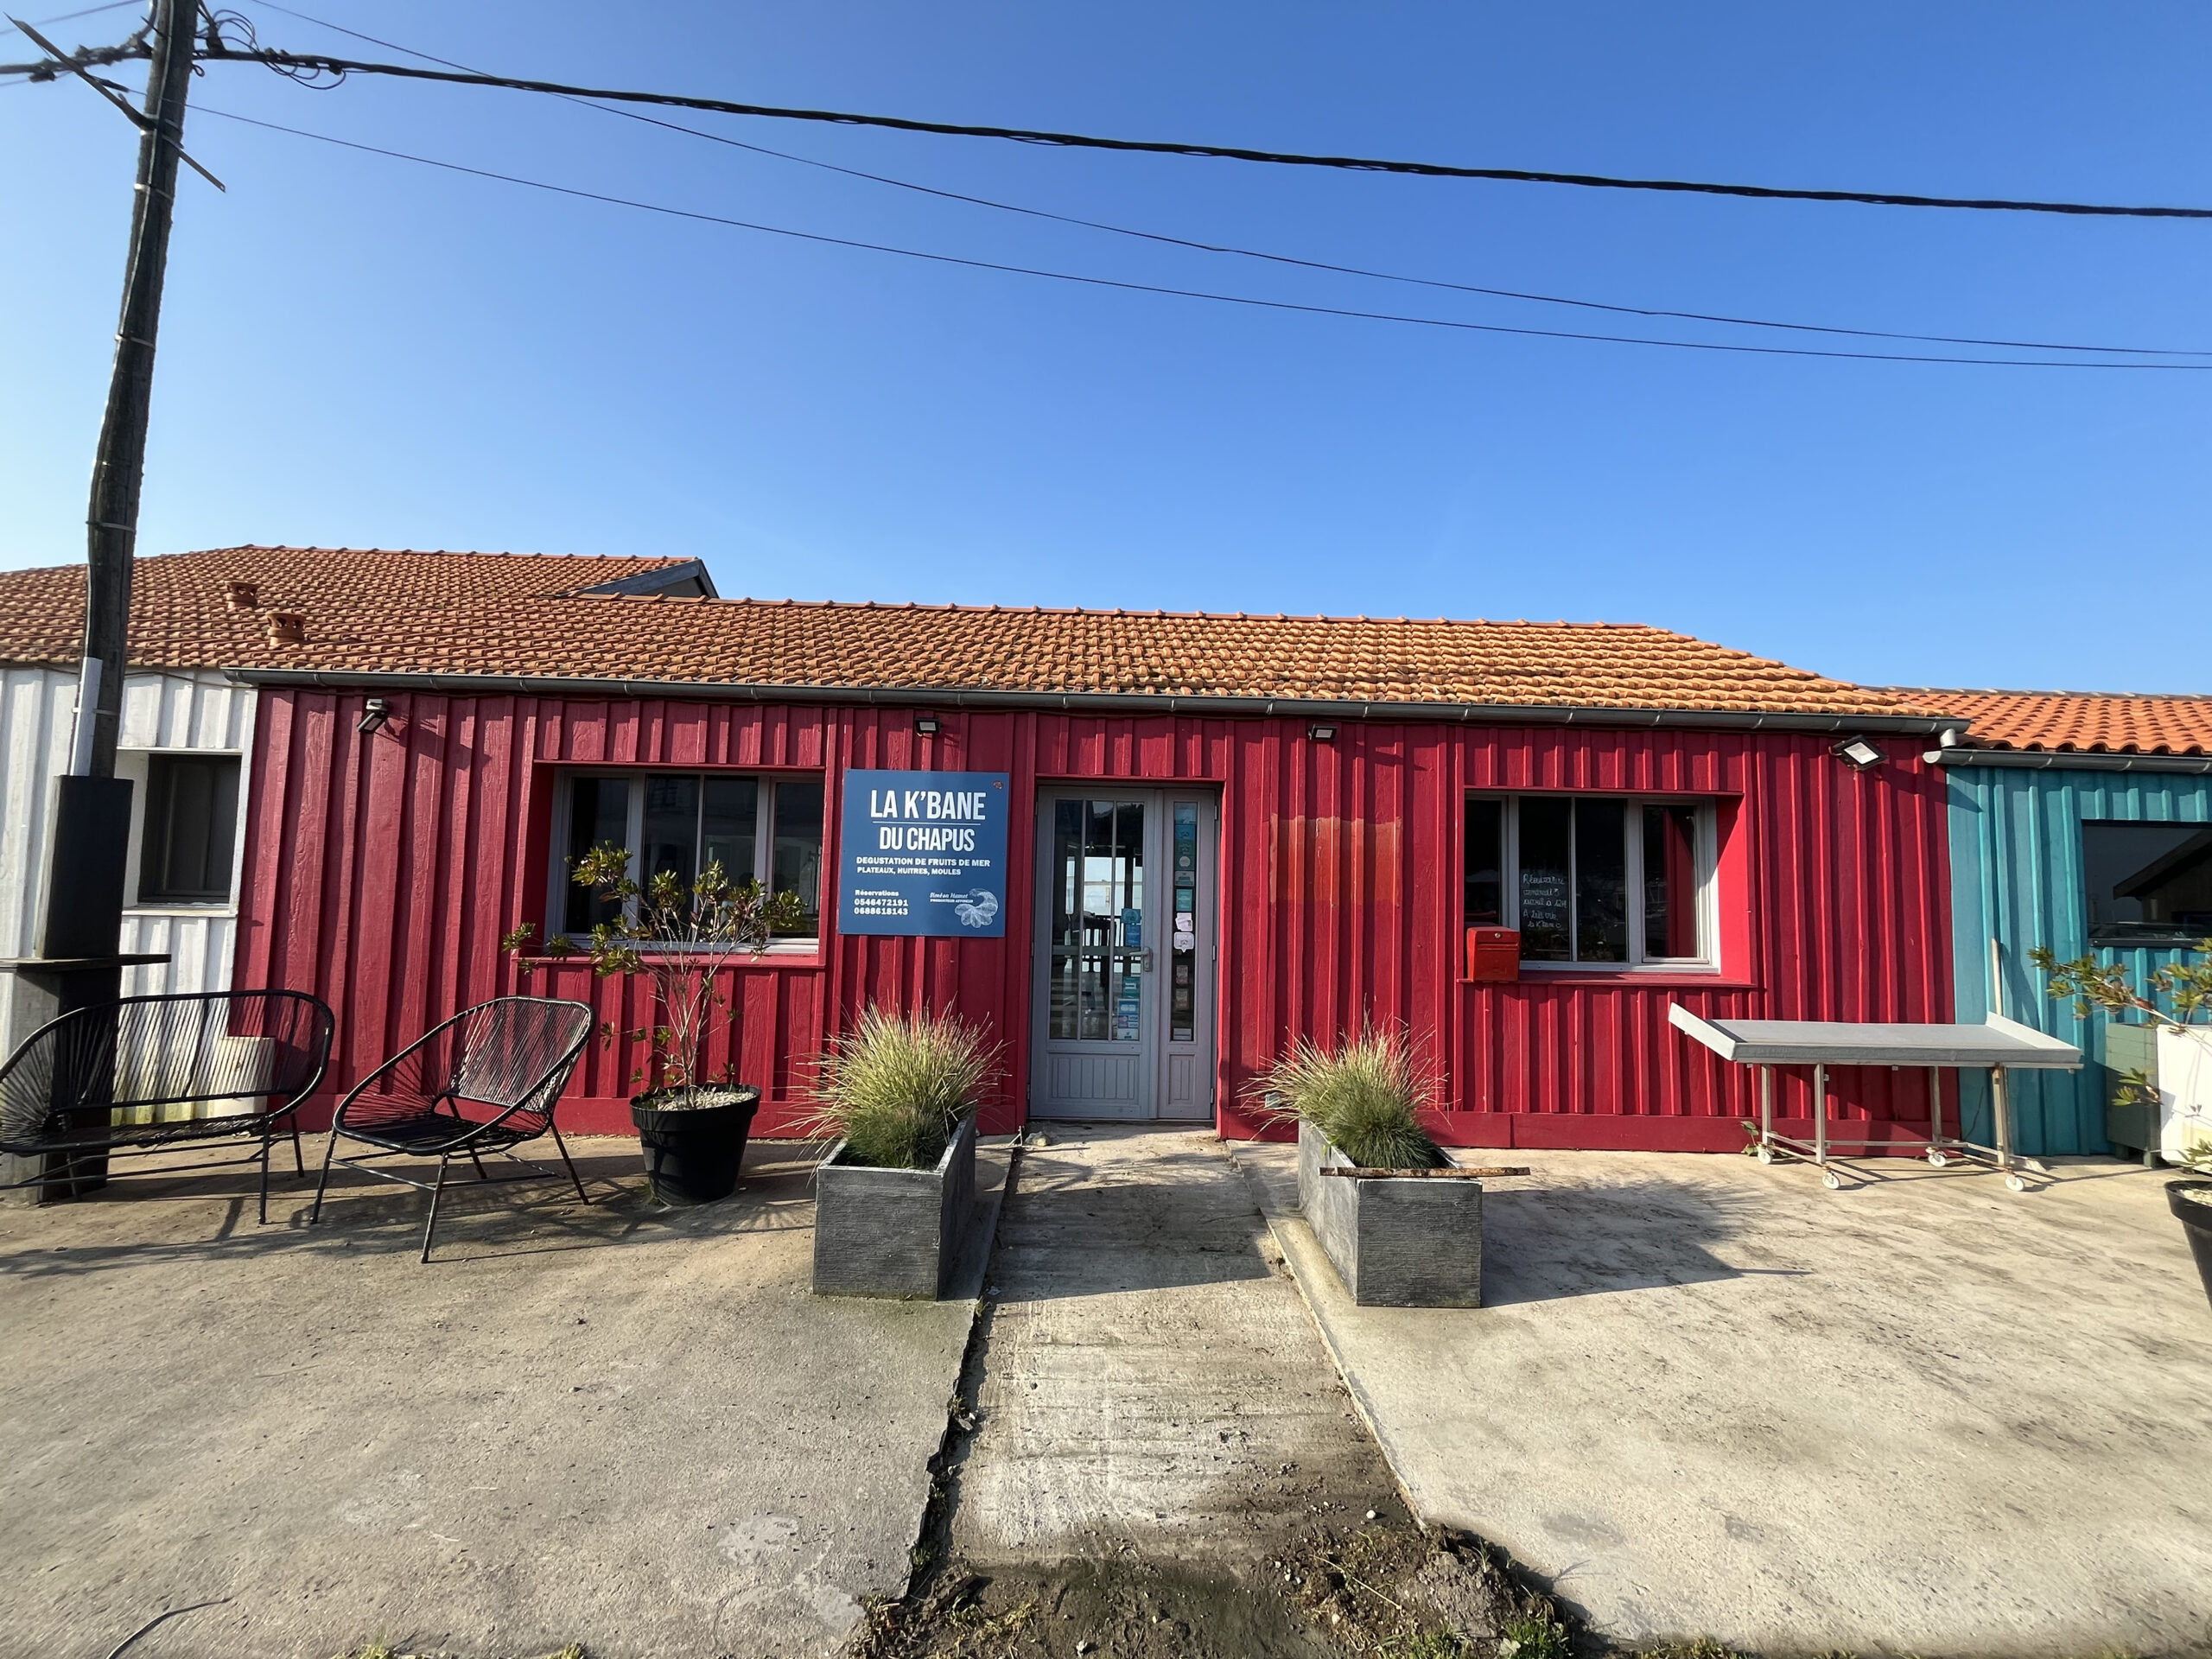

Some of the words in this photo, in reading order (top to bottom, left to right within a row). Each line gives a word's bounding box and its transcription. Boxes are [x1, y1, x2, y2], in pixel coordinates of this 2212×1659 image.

[870, 789, 899, 818] LA
[904, 791, 987, 821] K'BANE
[879, 827, 904, 850] DU
[906, 827, 976, 852] CHAPUS
[856, 856, 913, 866] DEGUSTATION
[928, 858, 957, 867] FRUITS
[857, 867, 896, 875] PLATEAUX,
[897, 868, 931, 876] HUITRES,
[854, 898, 909, 907] 0546472191
